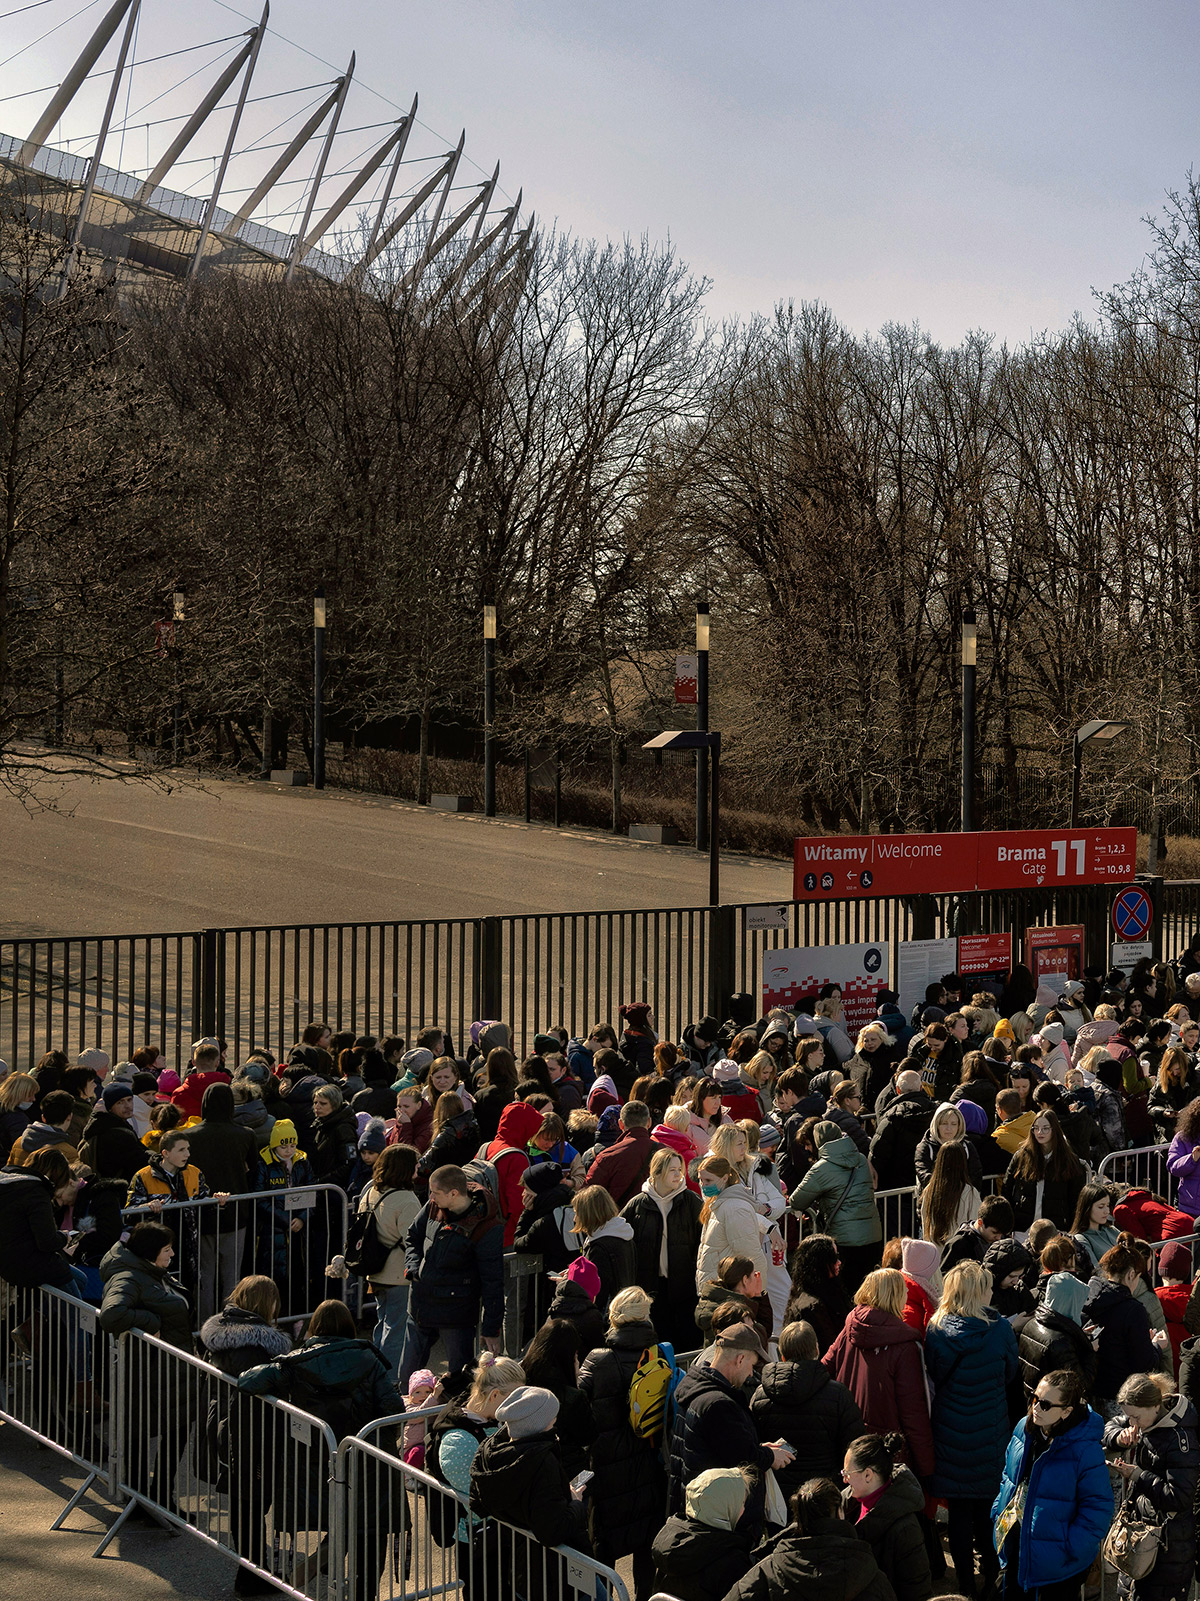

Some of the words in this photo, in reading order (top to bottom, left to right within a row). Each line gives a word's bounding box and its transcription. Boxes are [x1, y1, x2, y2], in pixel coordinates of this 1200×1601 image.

[804, 844, 868, 863] Witamy
[877, 843, 942, 859] Welcome
[997, 846, 1046, 861] Brama
[1108, 844, 1125, 854] 1,2,3
[1051, 840, 1086, 876] 11
[1022, 863, 1046, 874] Gate
[1107, 864, 1131, 874] 10,9,8
[280, 1137, 296, 1145] OBEY
